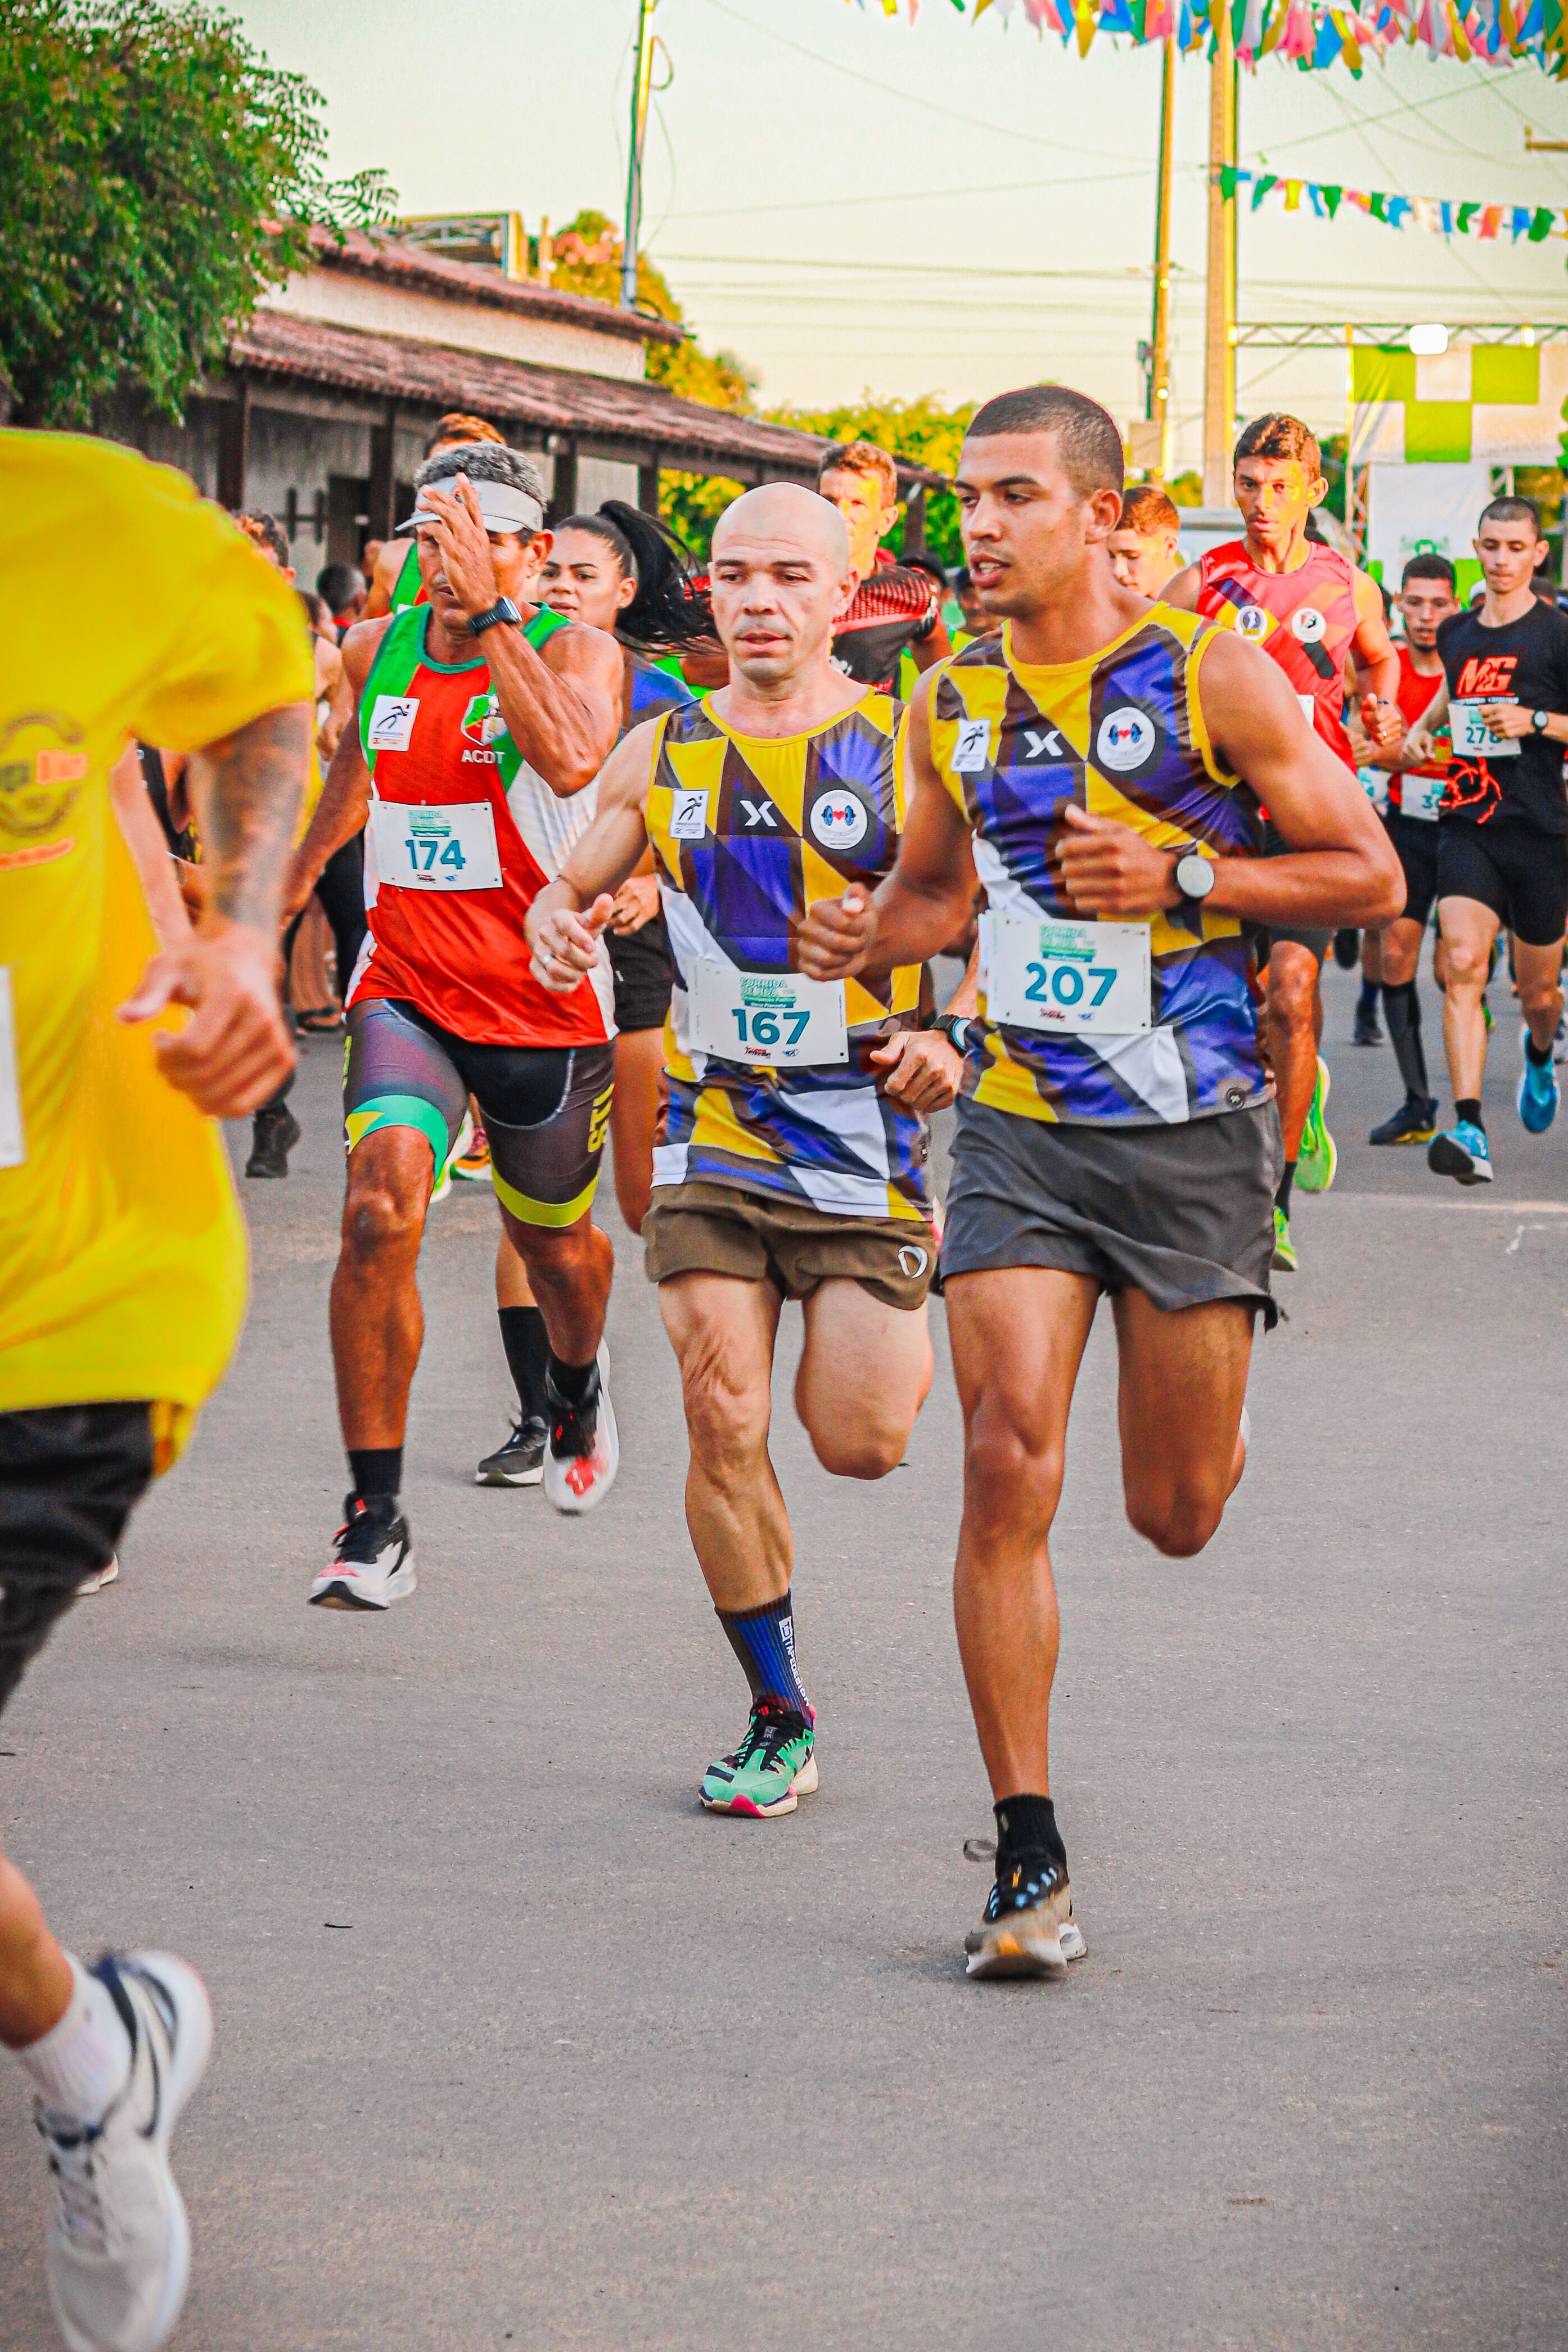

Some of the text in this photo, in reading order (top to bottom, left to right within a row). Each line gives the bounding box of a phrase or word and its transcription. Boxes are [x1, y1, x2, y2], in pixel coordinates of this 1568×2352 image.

[461, 749, 506, 764] ACDT
[405, 840, 466, 869] 174
[1025, 962, 1118, 1006] 207
[731, 1008, 810, 1045] 167
